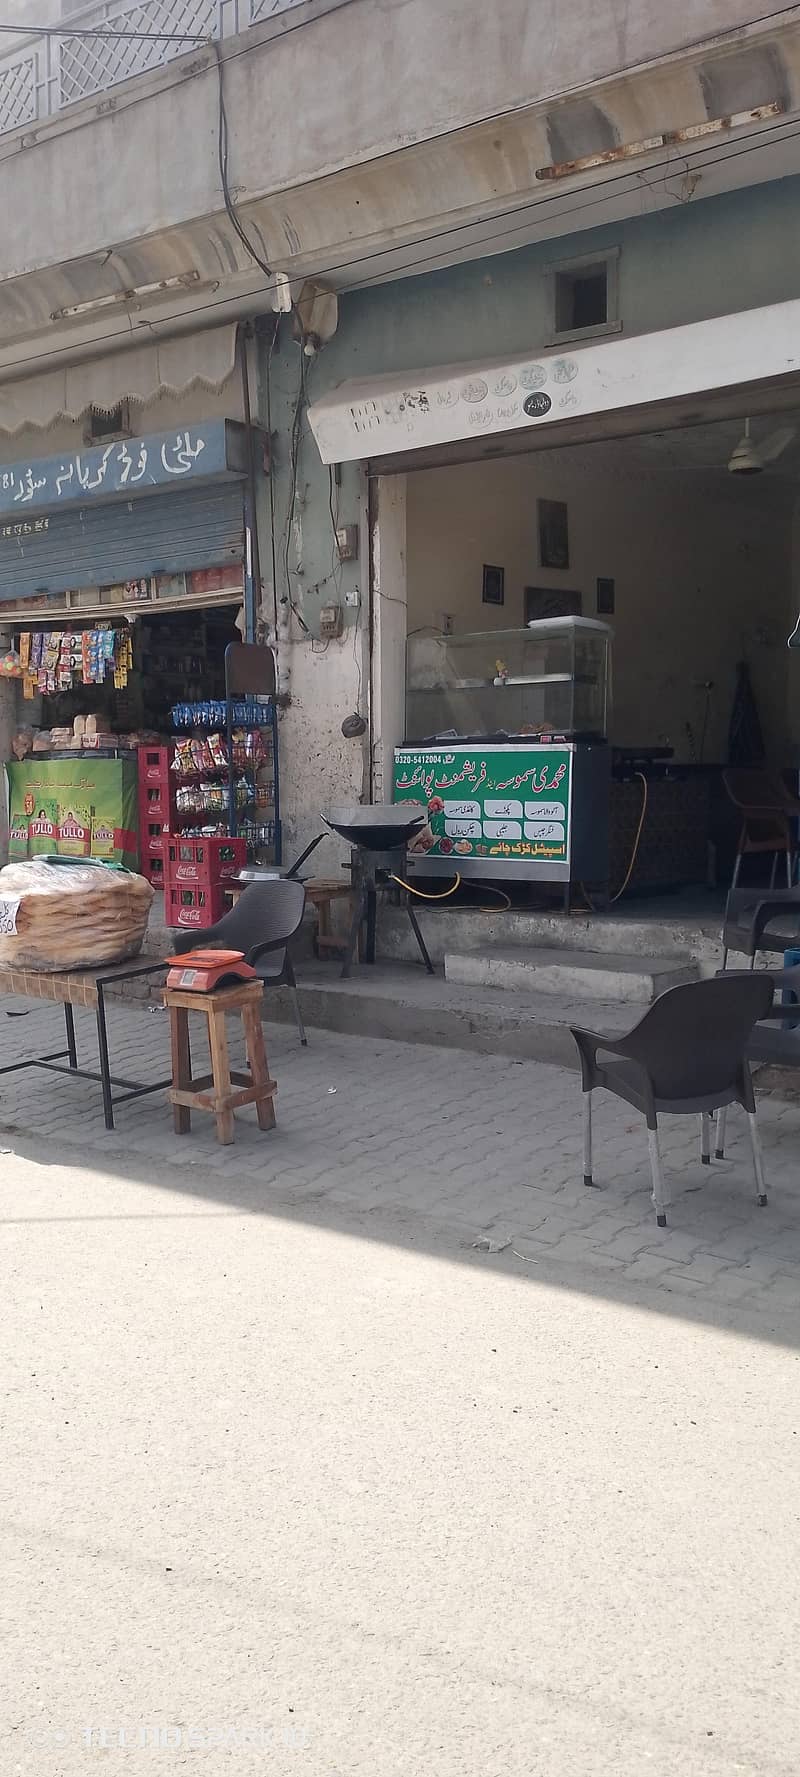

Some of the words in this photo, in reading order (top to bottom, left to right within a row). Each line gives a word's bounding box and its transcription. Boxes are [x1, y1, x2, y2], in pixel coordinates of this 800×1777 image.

[117, 441, 148, 483] فوڈ
[394, 754, 442, 765] 0320-5412004
[396, 766, 435, 798] پوائنٹ
[496, 767, 536, 790] سموسہ
[532, 763, 567, 793] محمدی
[32, 822, 53, 835] TULLO
[58, 827, 85, 839] TULLO
